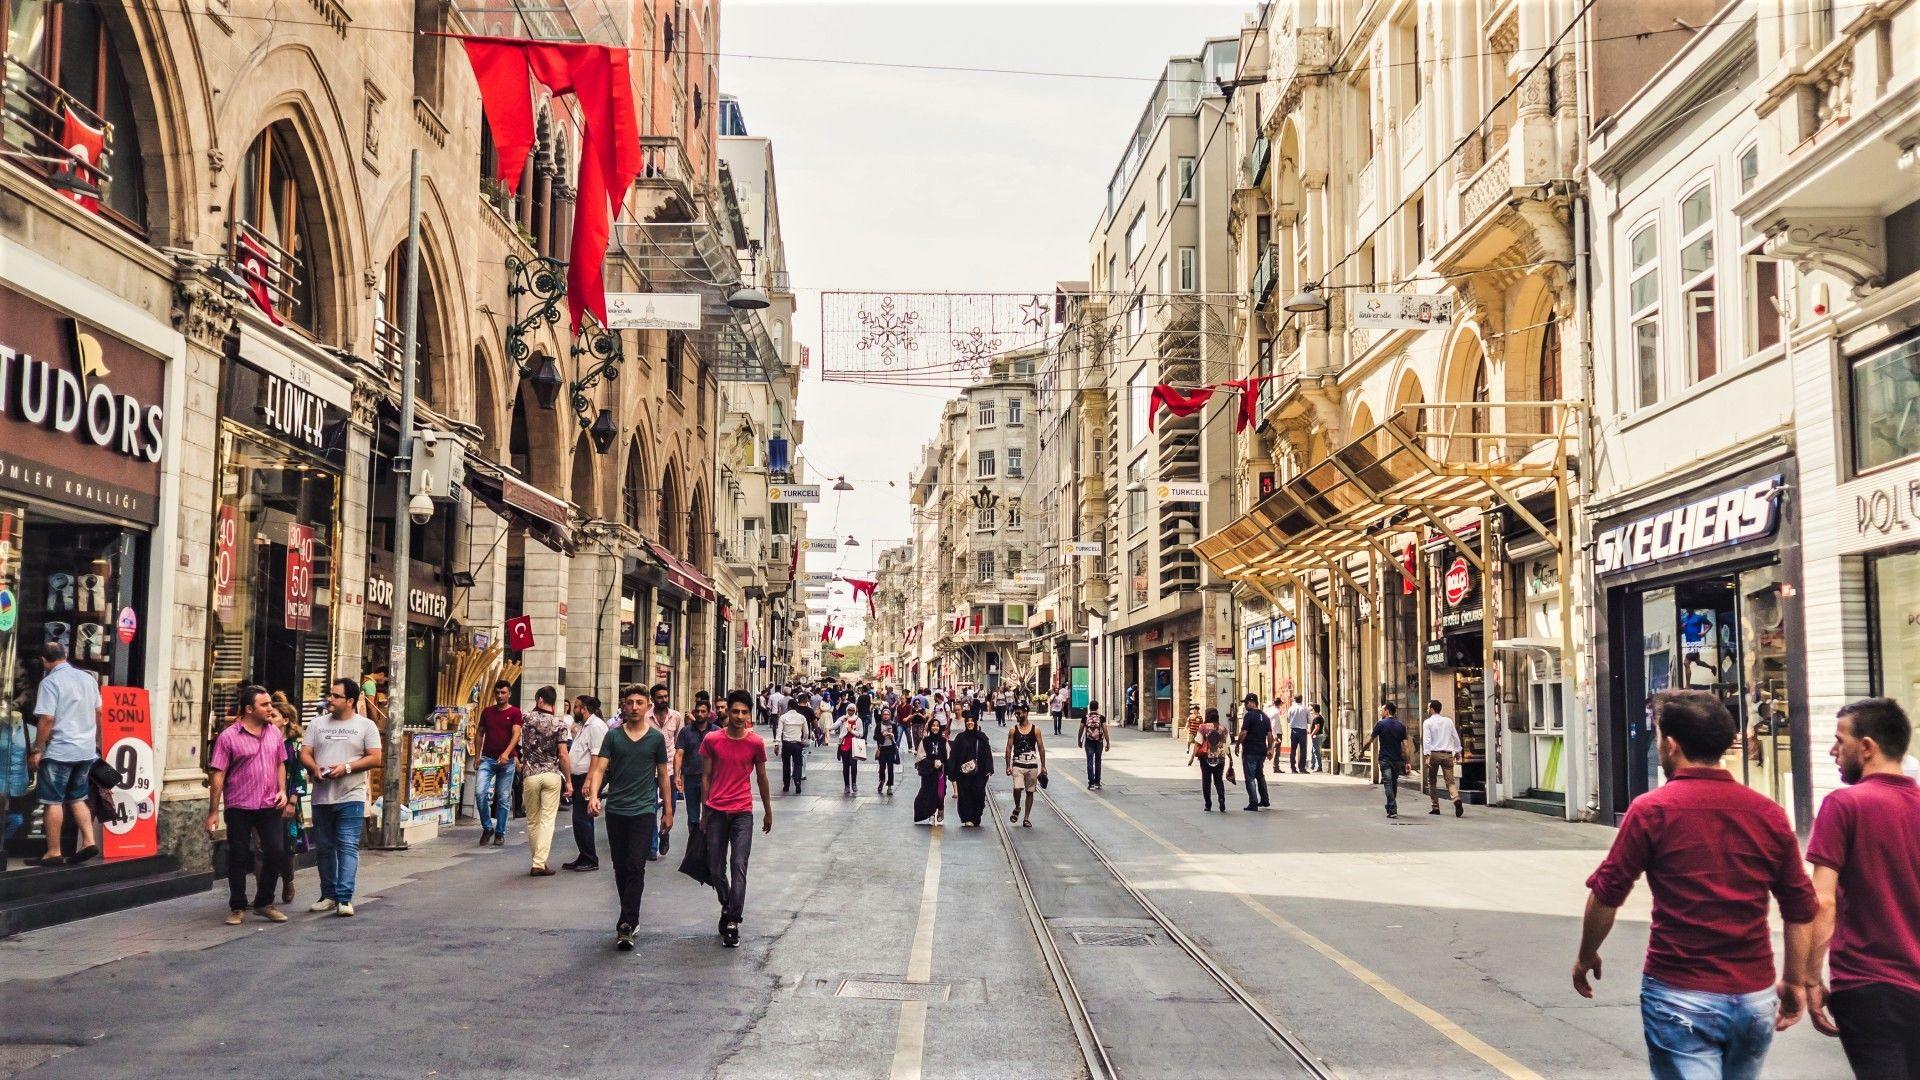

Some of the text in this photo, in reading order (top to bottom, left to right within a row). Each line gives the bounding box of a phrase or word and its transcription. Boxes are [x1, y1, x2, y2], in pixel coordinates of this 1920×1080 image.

[0, 344, 163, 463] TUDORS
[264, 374, 326, 449] FLOWER
[0, 460, 136, 510] ÖMLEK KRALLIĞI
[1171, 488, 1208, 496] TURKCELL
[1595, 479, 1772, 575] SKECHERS
[291, 566, 308, 598] 50
[409, 588, 447, 620] CENTER
[112, 692, 137, 707] YAZ
[108, 709, 144, 723] SONU
[338, 728, 359, 736] Mode
